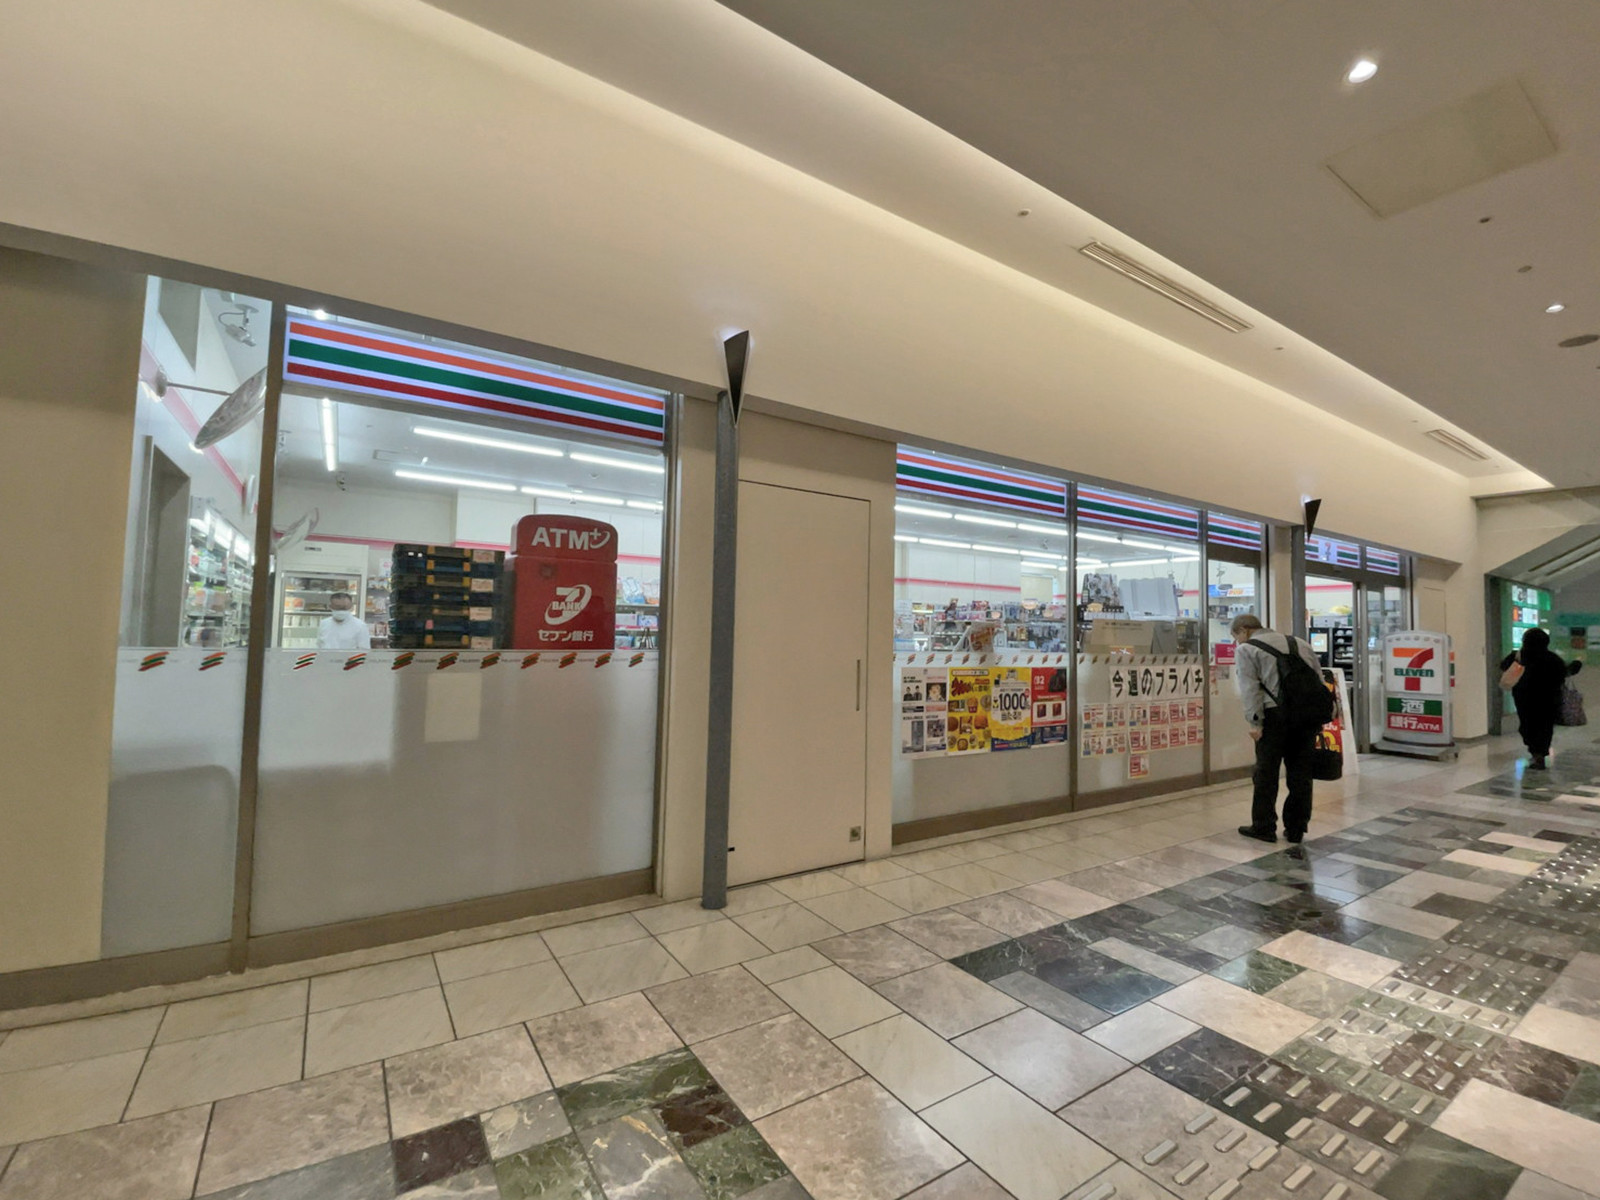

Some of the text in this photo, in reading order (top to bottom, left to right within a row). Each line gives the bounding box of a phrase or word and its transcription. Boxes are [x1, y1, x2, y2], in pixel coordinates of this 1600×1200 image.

[551, 601, 582, 611] BANK
[538, 629, 594, 642] セブン銀行
[1392, 647, 1434, 691] 7
[998, 692, 1027, 711] 1000
[1401, 699, 1425, 715] 酒
